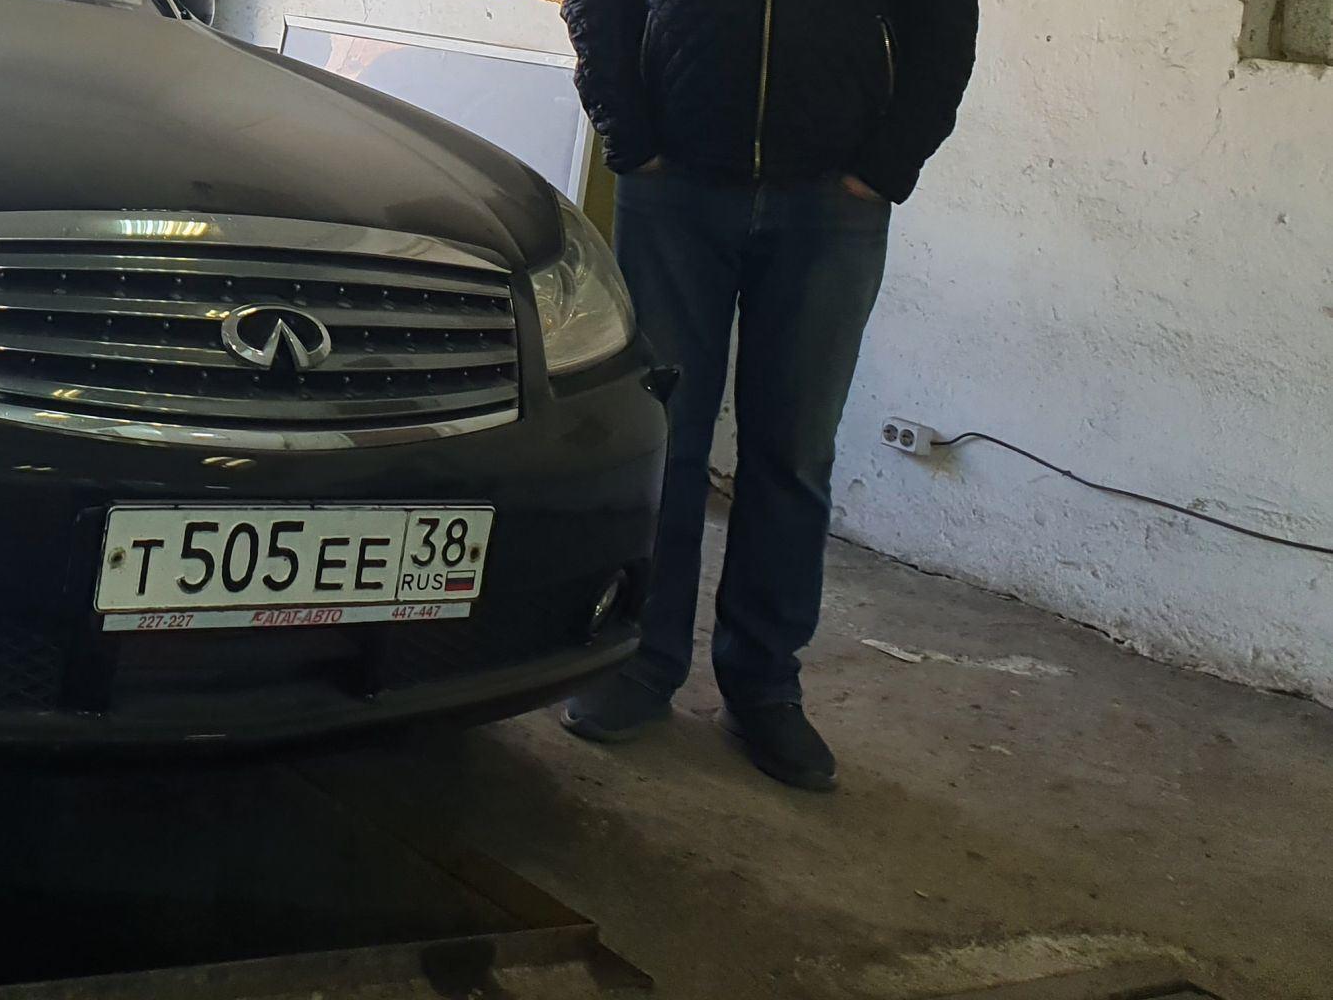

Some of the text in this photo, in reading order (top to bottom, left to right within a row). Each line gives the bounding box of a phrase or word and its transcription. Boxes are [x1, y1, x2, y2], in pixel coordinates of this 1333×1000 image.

[411, 517, 468, 568] 38
[401, 573, 444, 591] RUS
[137, 614, 194, 629] 227-227
[391, 605, 442, 619] 447-447
